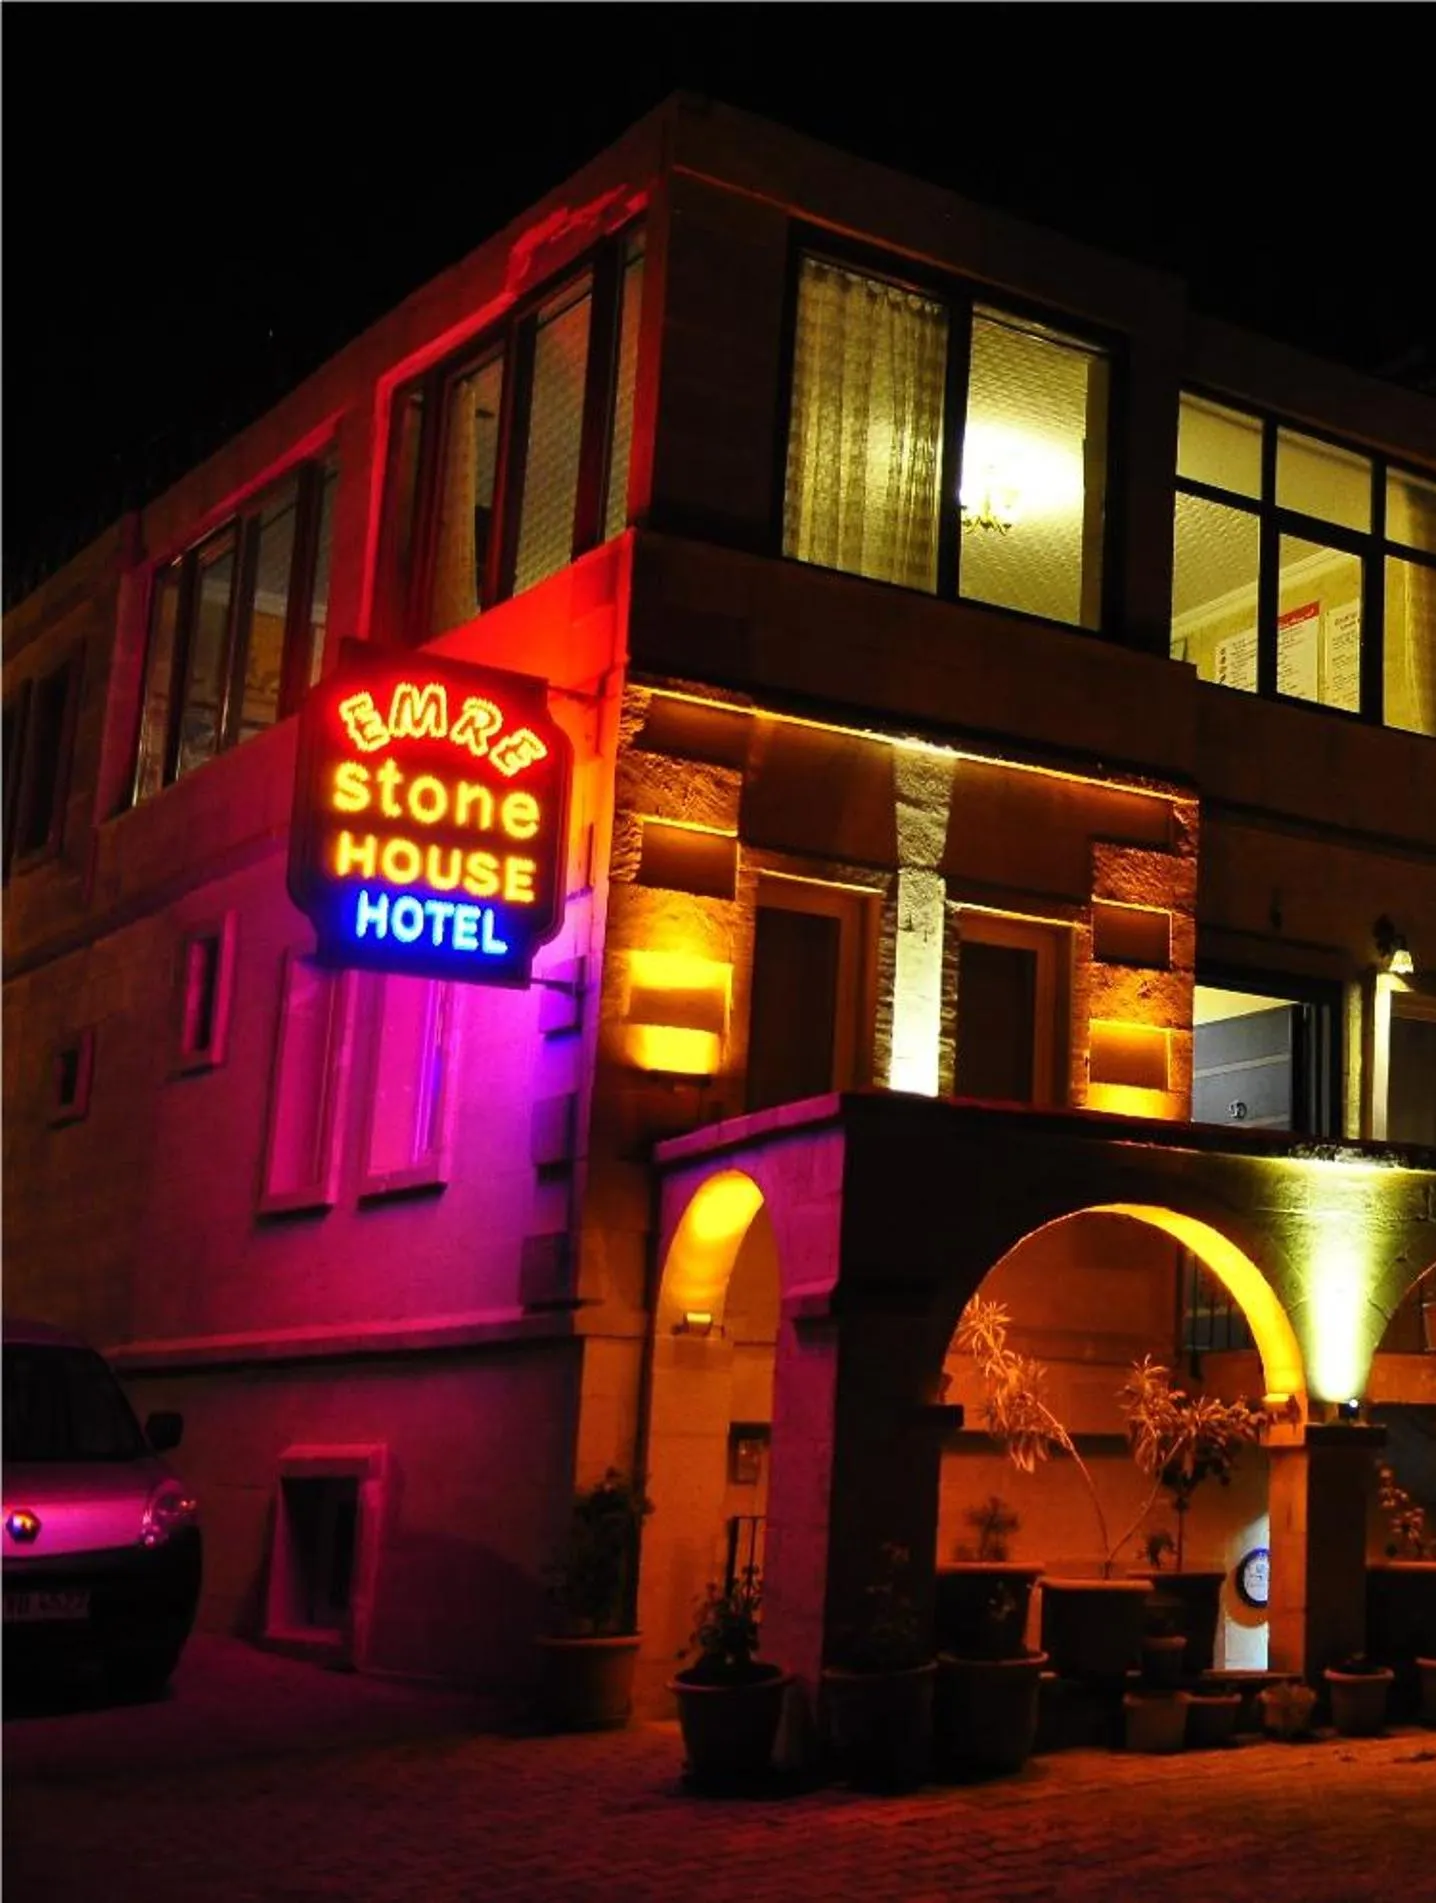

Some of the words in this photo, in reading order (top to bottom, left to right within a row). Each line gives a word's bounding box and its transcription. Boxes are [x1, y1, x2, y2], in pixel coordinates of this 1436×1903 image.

[339, 683, 548, 777] EMRE
[332, 759, 540, 839] stone
[336, 830, 536, 903] HOUSE
[356, 890, 508, 954] HOTEL
